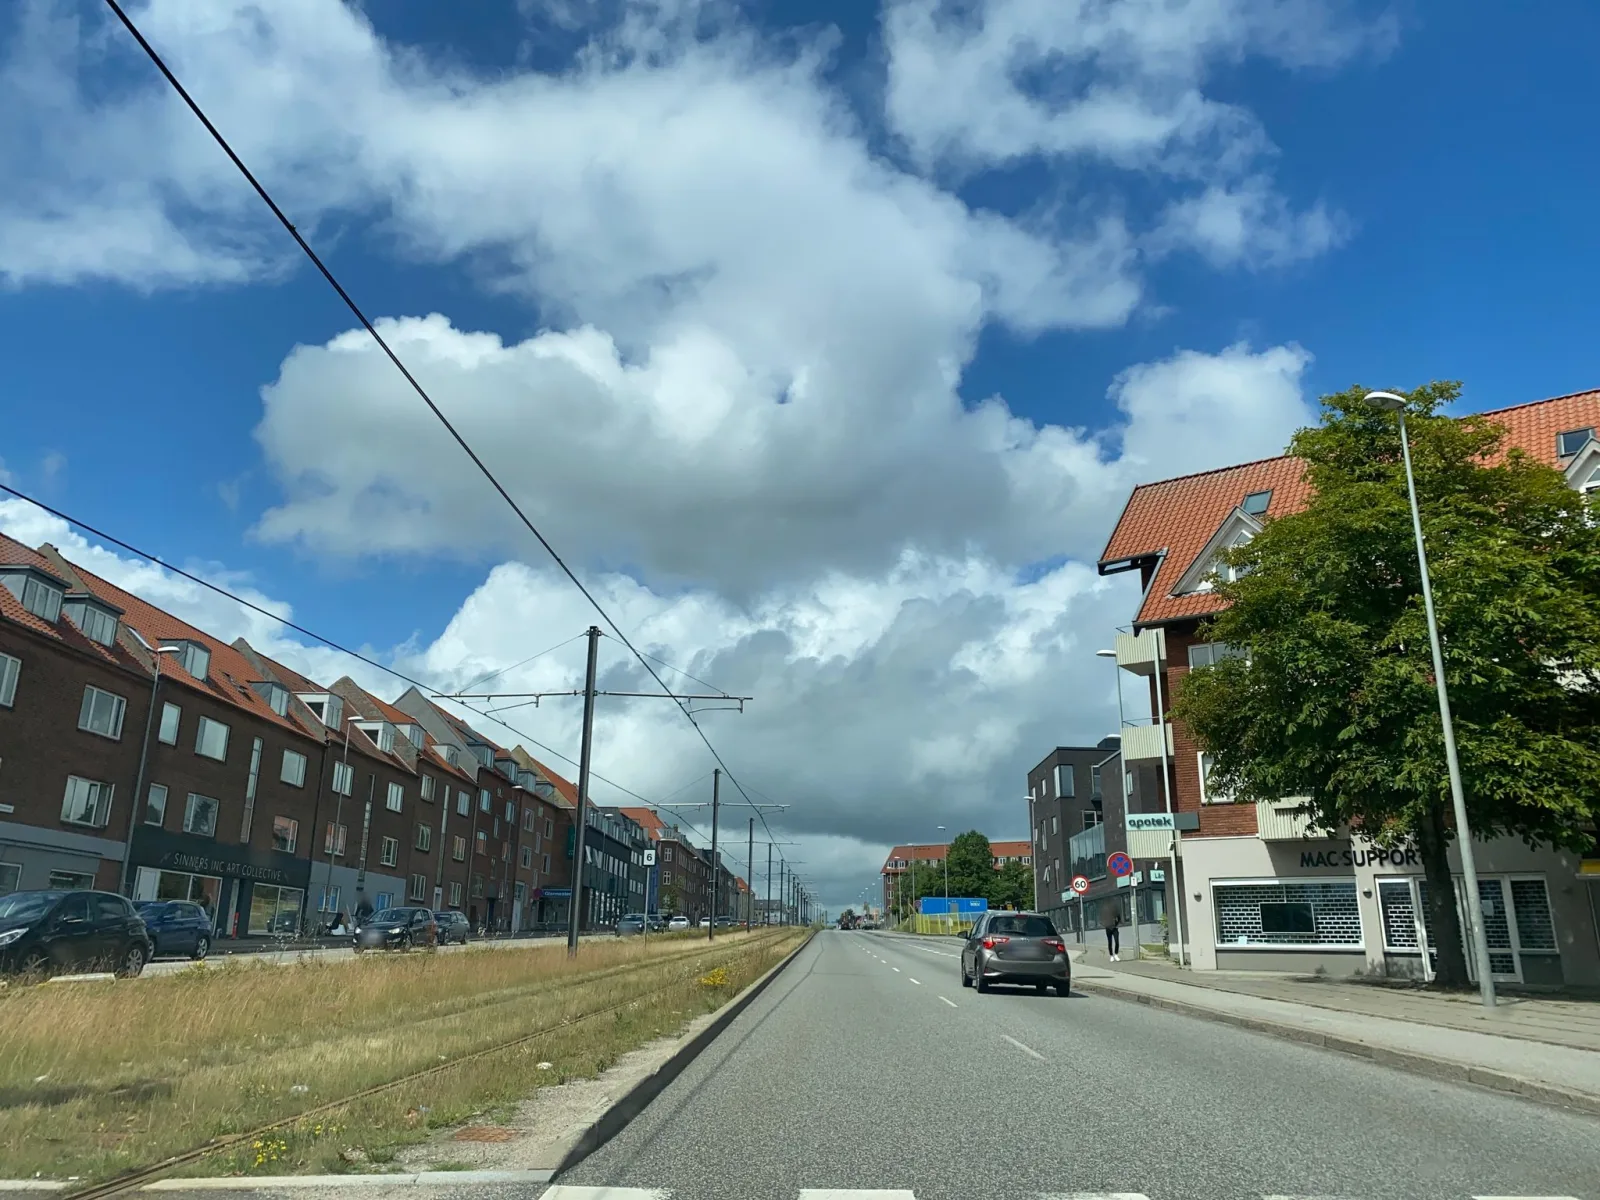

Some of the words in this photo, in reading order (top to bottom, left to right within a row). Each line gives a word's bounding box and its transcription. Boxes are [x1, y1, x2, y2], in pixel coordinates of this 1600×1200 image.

[1128, 816, 1172, 829] apotek
[646, 853, 653, 862] 6
[1300, 850, 1339, 868] MAC
[173, 852, 209, 870] SINNERS
[210, 860, 225, 873] INC
[226, 863, 241, 875] ART
[241, 865, 282, 881] COLLECTIVE
[1074, 880, 1087, 889] 60
